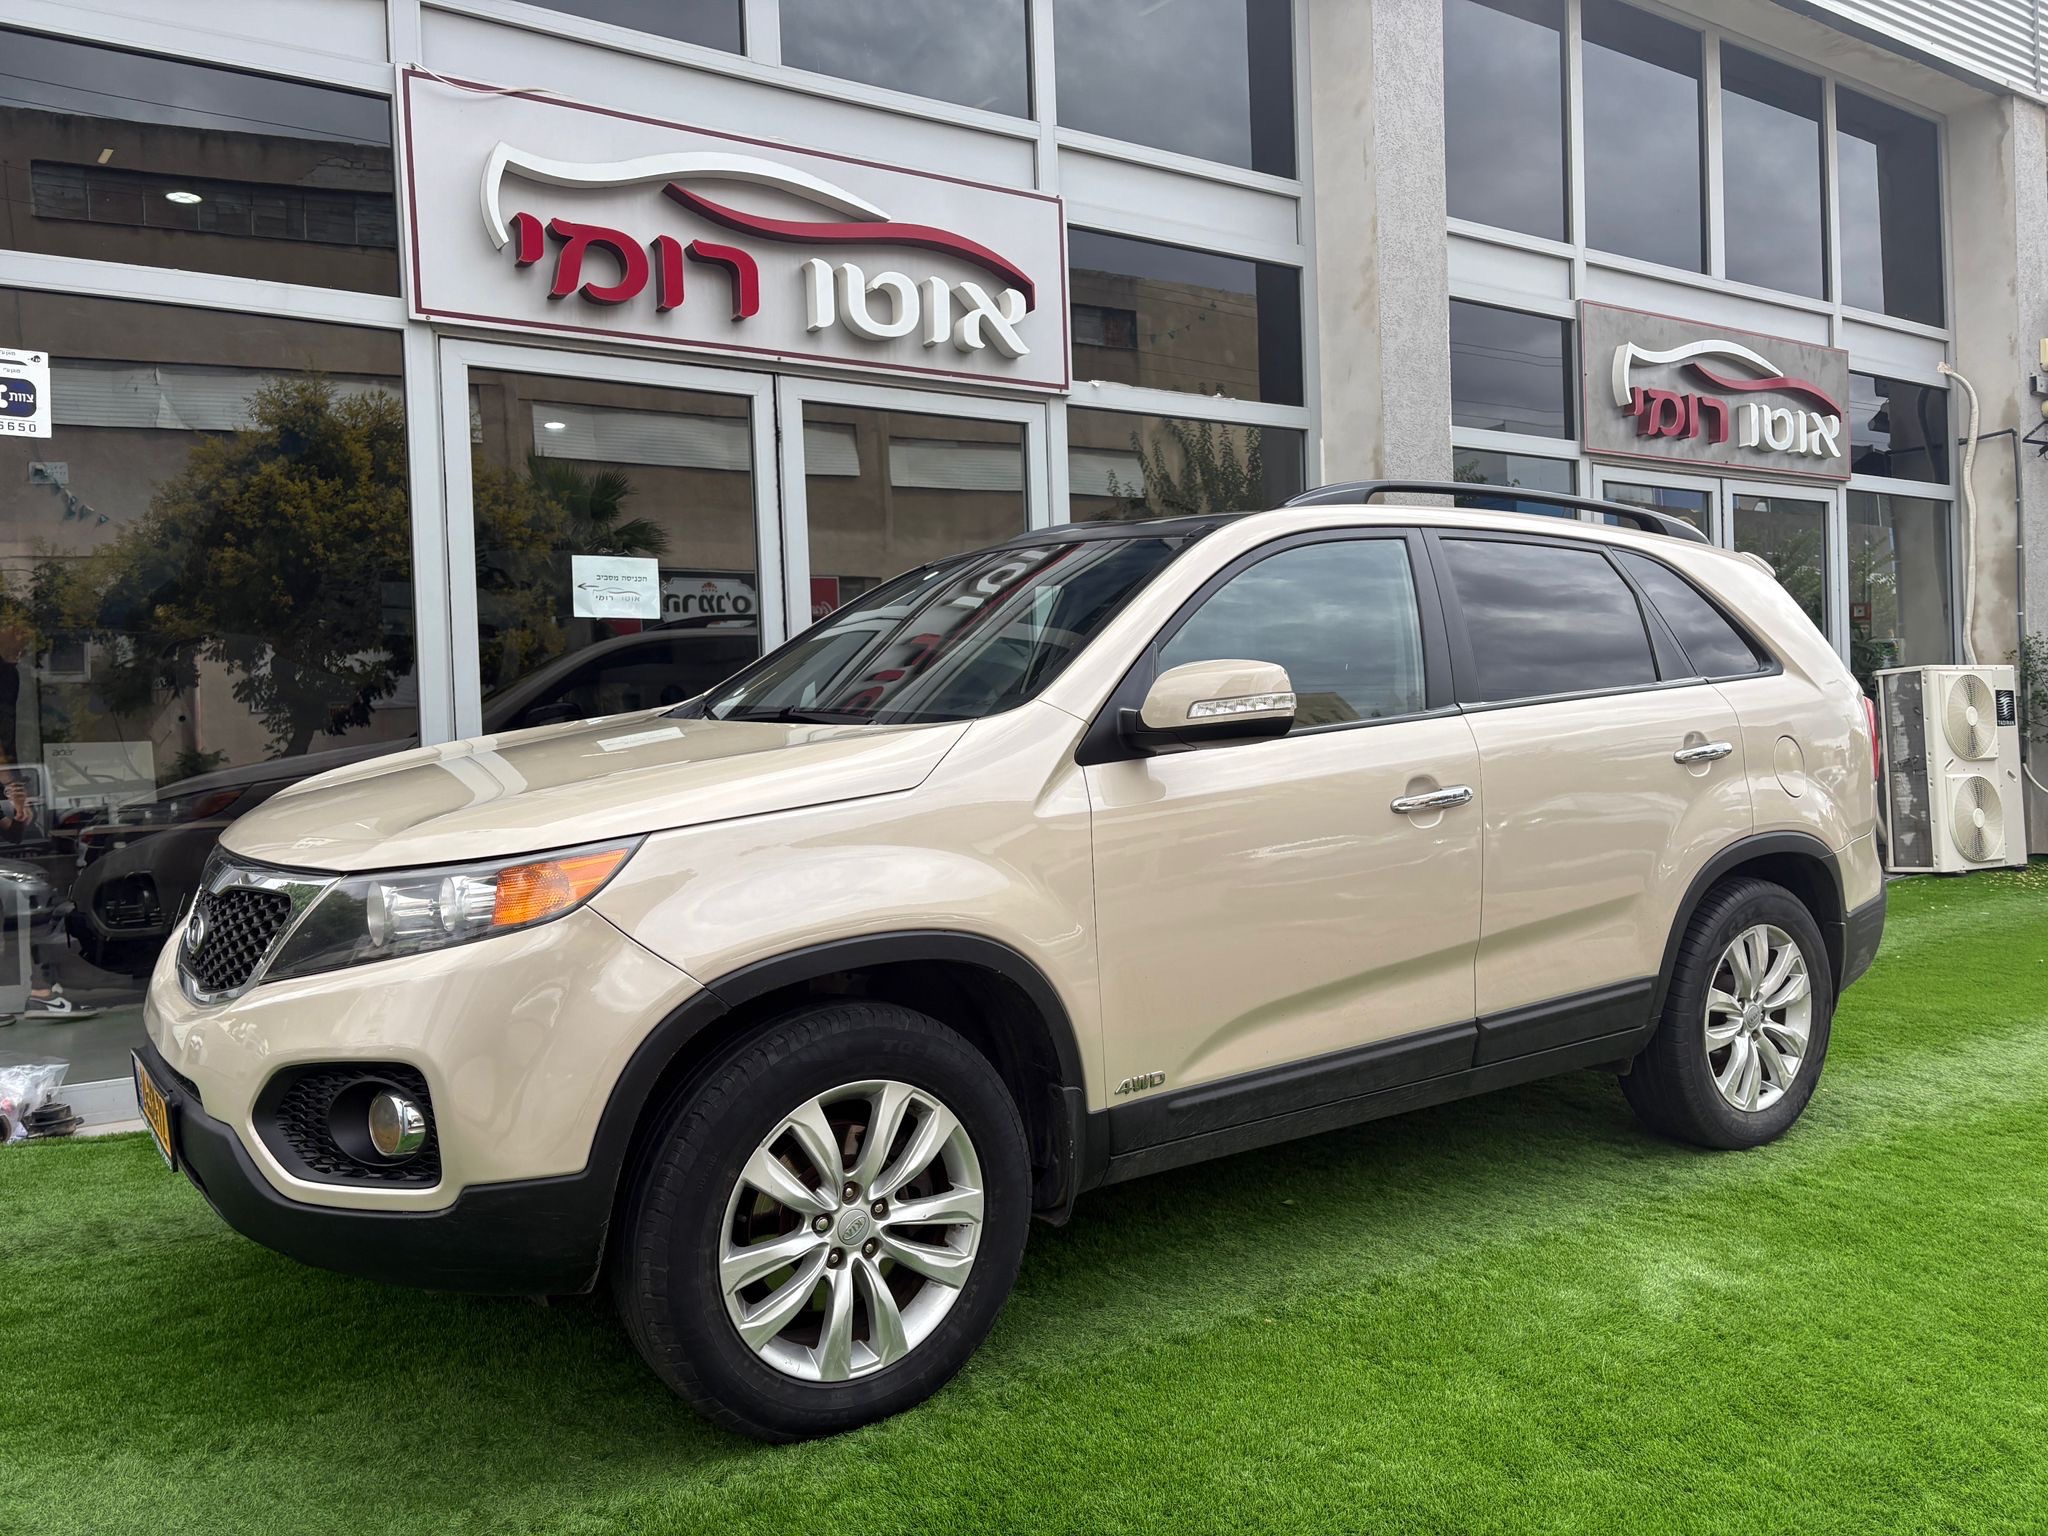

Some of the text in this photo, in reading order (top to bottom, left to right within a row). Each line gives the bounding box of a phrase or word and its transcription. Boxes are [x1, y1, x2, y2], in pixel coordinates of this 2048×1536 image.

[508, 211, 1031, 359] אוטו רומי
[8, 392, 34, 403] צוות
[1622, 386, 1842, 458] אוטו רומי
[596, 574, 619, 582] מסביב
[595, 594, 614, 602] רומי
[51, 748, 77, 757] acer
[1114, 1070, 1166, 1096] 4WD
[843, 1218, 864, 1238] KIA
